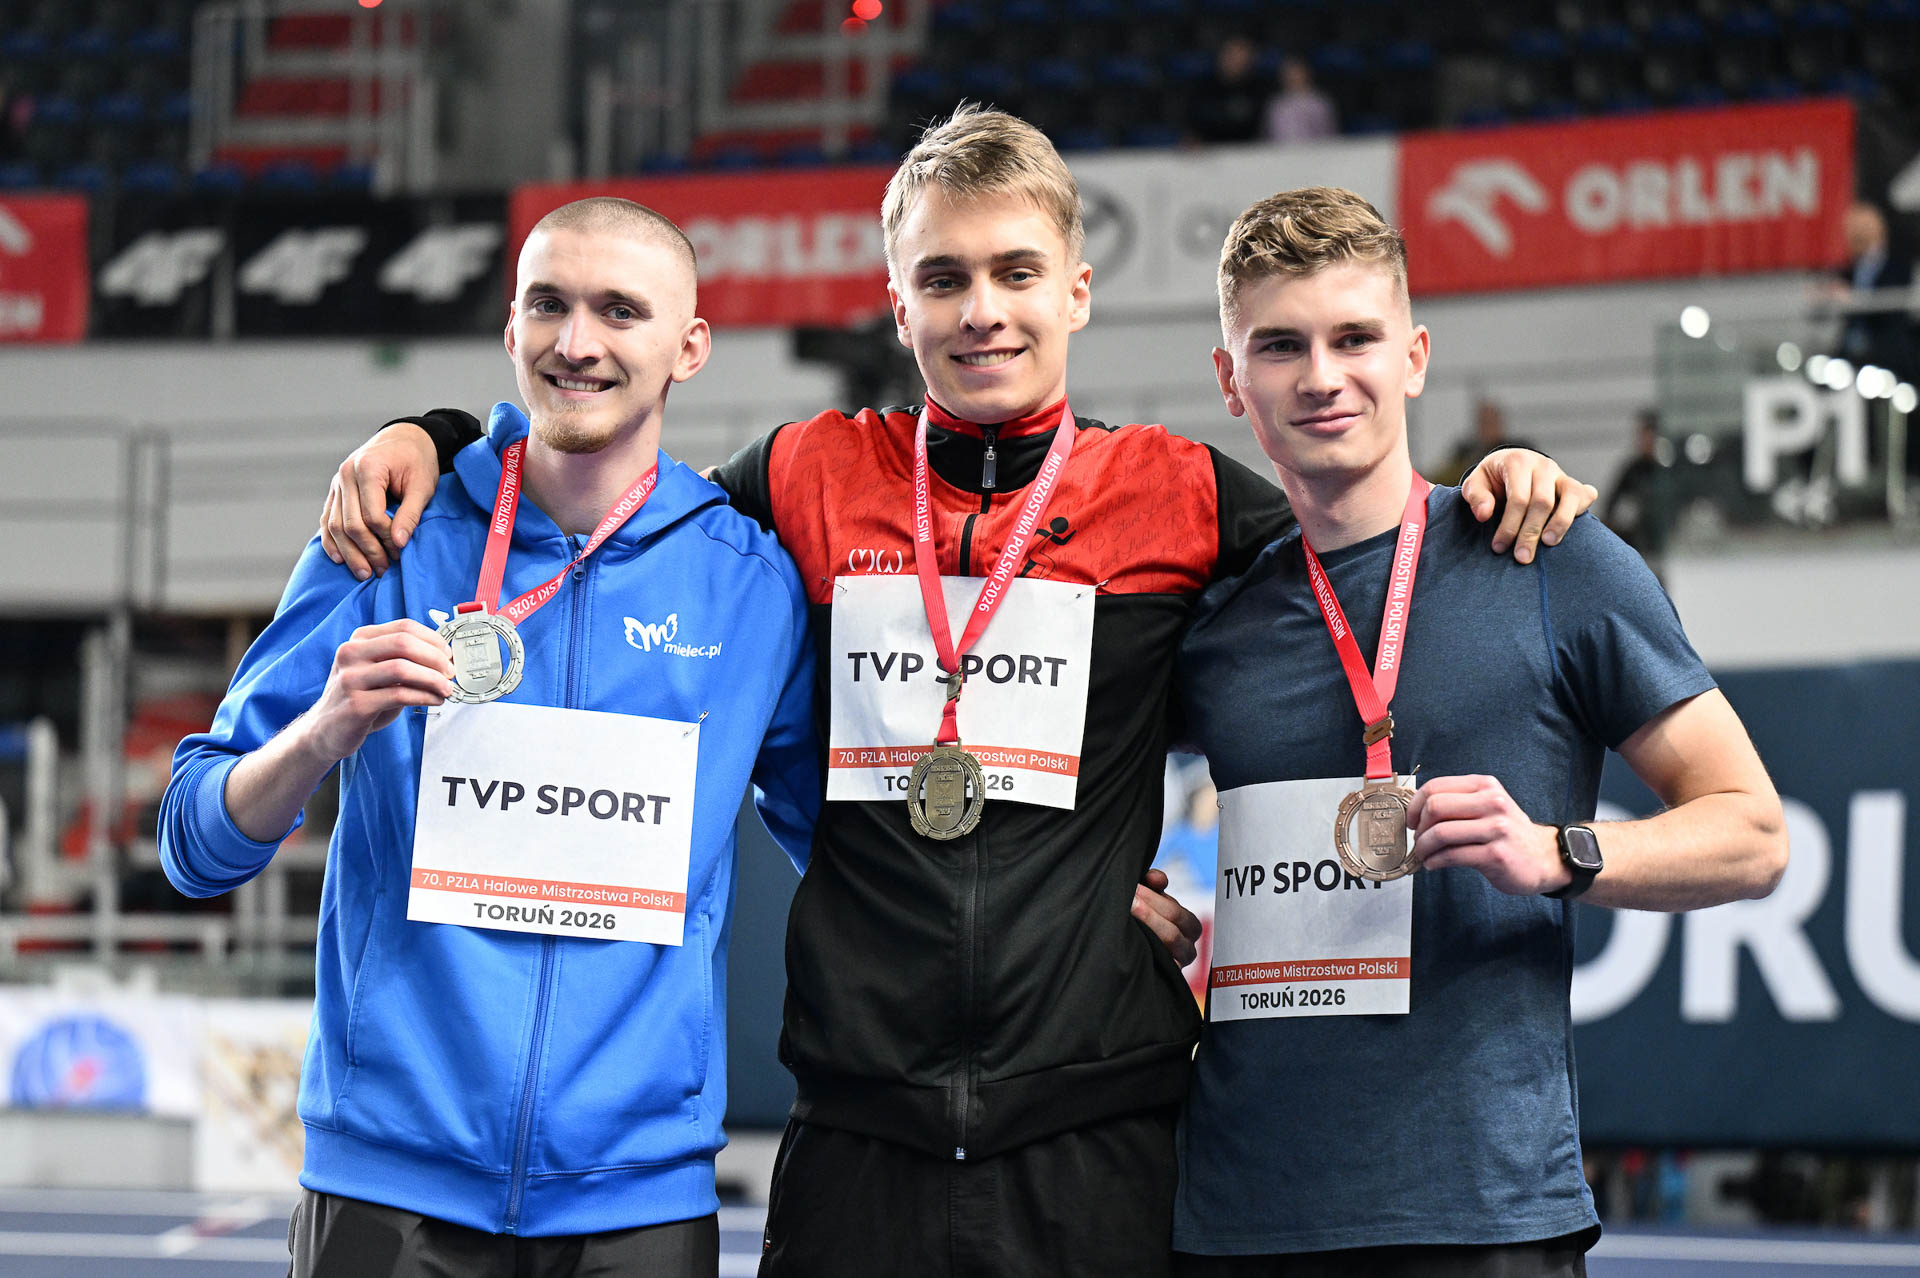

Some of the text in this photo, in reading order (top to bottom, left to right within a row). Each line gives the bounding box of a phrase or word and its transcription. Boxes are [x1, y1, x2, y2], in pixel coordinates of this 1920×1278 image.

[1566, 150, 1822, 233] ORLEN
[99, 228, 226, 301] 4F
[239, 225, 368, 300] 4F
[377, 222, 502, 299] 4F
[1744, 378, 1867, 491] P1
[494, 471, 518, 536] MISTRZOSTWA
[613, 484, 646, 517] POLSKI
[643, 470, 657, 492] 2026
[915, 459, 930, 542] MISTRZOSTWA
[978, 452, 1063, 613] MISTRZOSTWA POLSKI 2026
[508, 572, 566, 619] LSKI 2026
[1315, 575, 1346, 640] MISTRZOSTWA
[1380, 522, 1419, 670] MISTRZOSTWA POLSKI 2026
[663, 642, 722, 659] mielec.pl
[848, 652, 924, 682] TVP
[839, 750, 1068, 770] 70. PZLA Halo zostwa Polski
[441, 776, 671, 825] TVP SPORT
[421, 872, 673, 908] 70. PZLA Halowe Mistrzostwa Polski
[1224, 859, 1383, 899] TVP SPO
[473, 902, 616, 930] TORUŃ 2026
[1216, 961, 1398, 982] 70. PZLA Halowe Mistrzostwa Polski
[1240, 986, 1346, 1010] TORUŃ 2026
